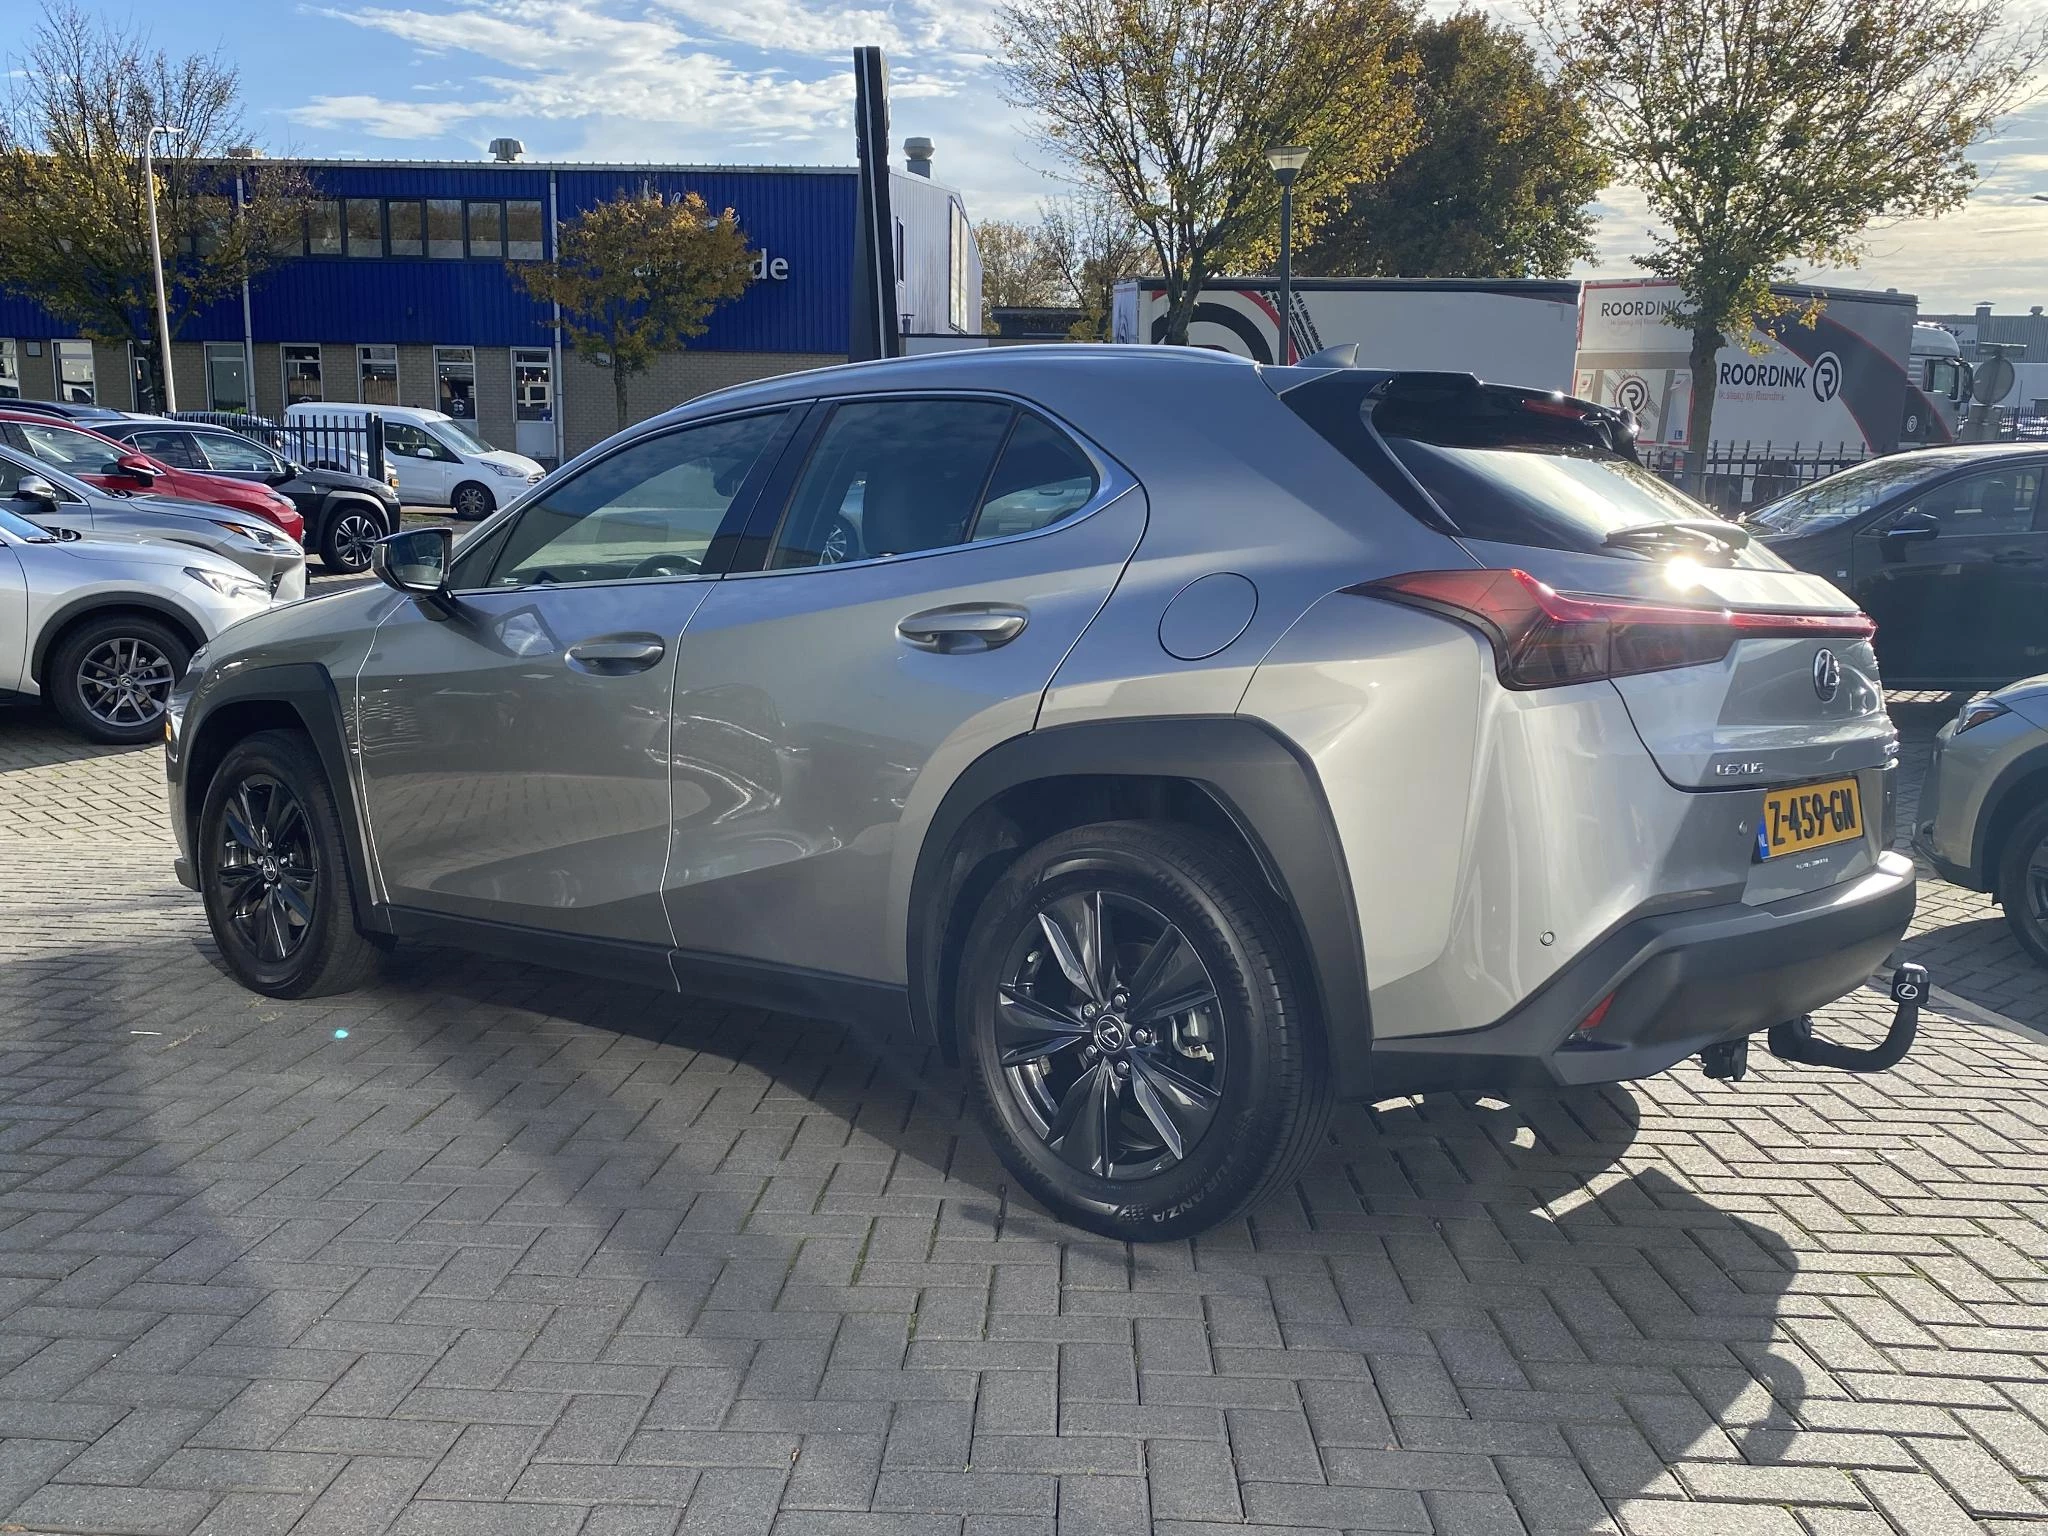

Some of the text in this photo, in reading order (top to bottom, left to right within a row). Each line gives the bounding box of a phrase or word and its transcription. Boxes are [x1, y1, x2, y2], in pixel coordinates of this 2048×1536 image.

[1601, 299, 1683, 317] ROORDINK
[1719, 362, 1808, 389] ROORDINK
[1716, 762, 1765, 776] LEXUS
[1768, 788, 1856, 846] Z-459-GN
